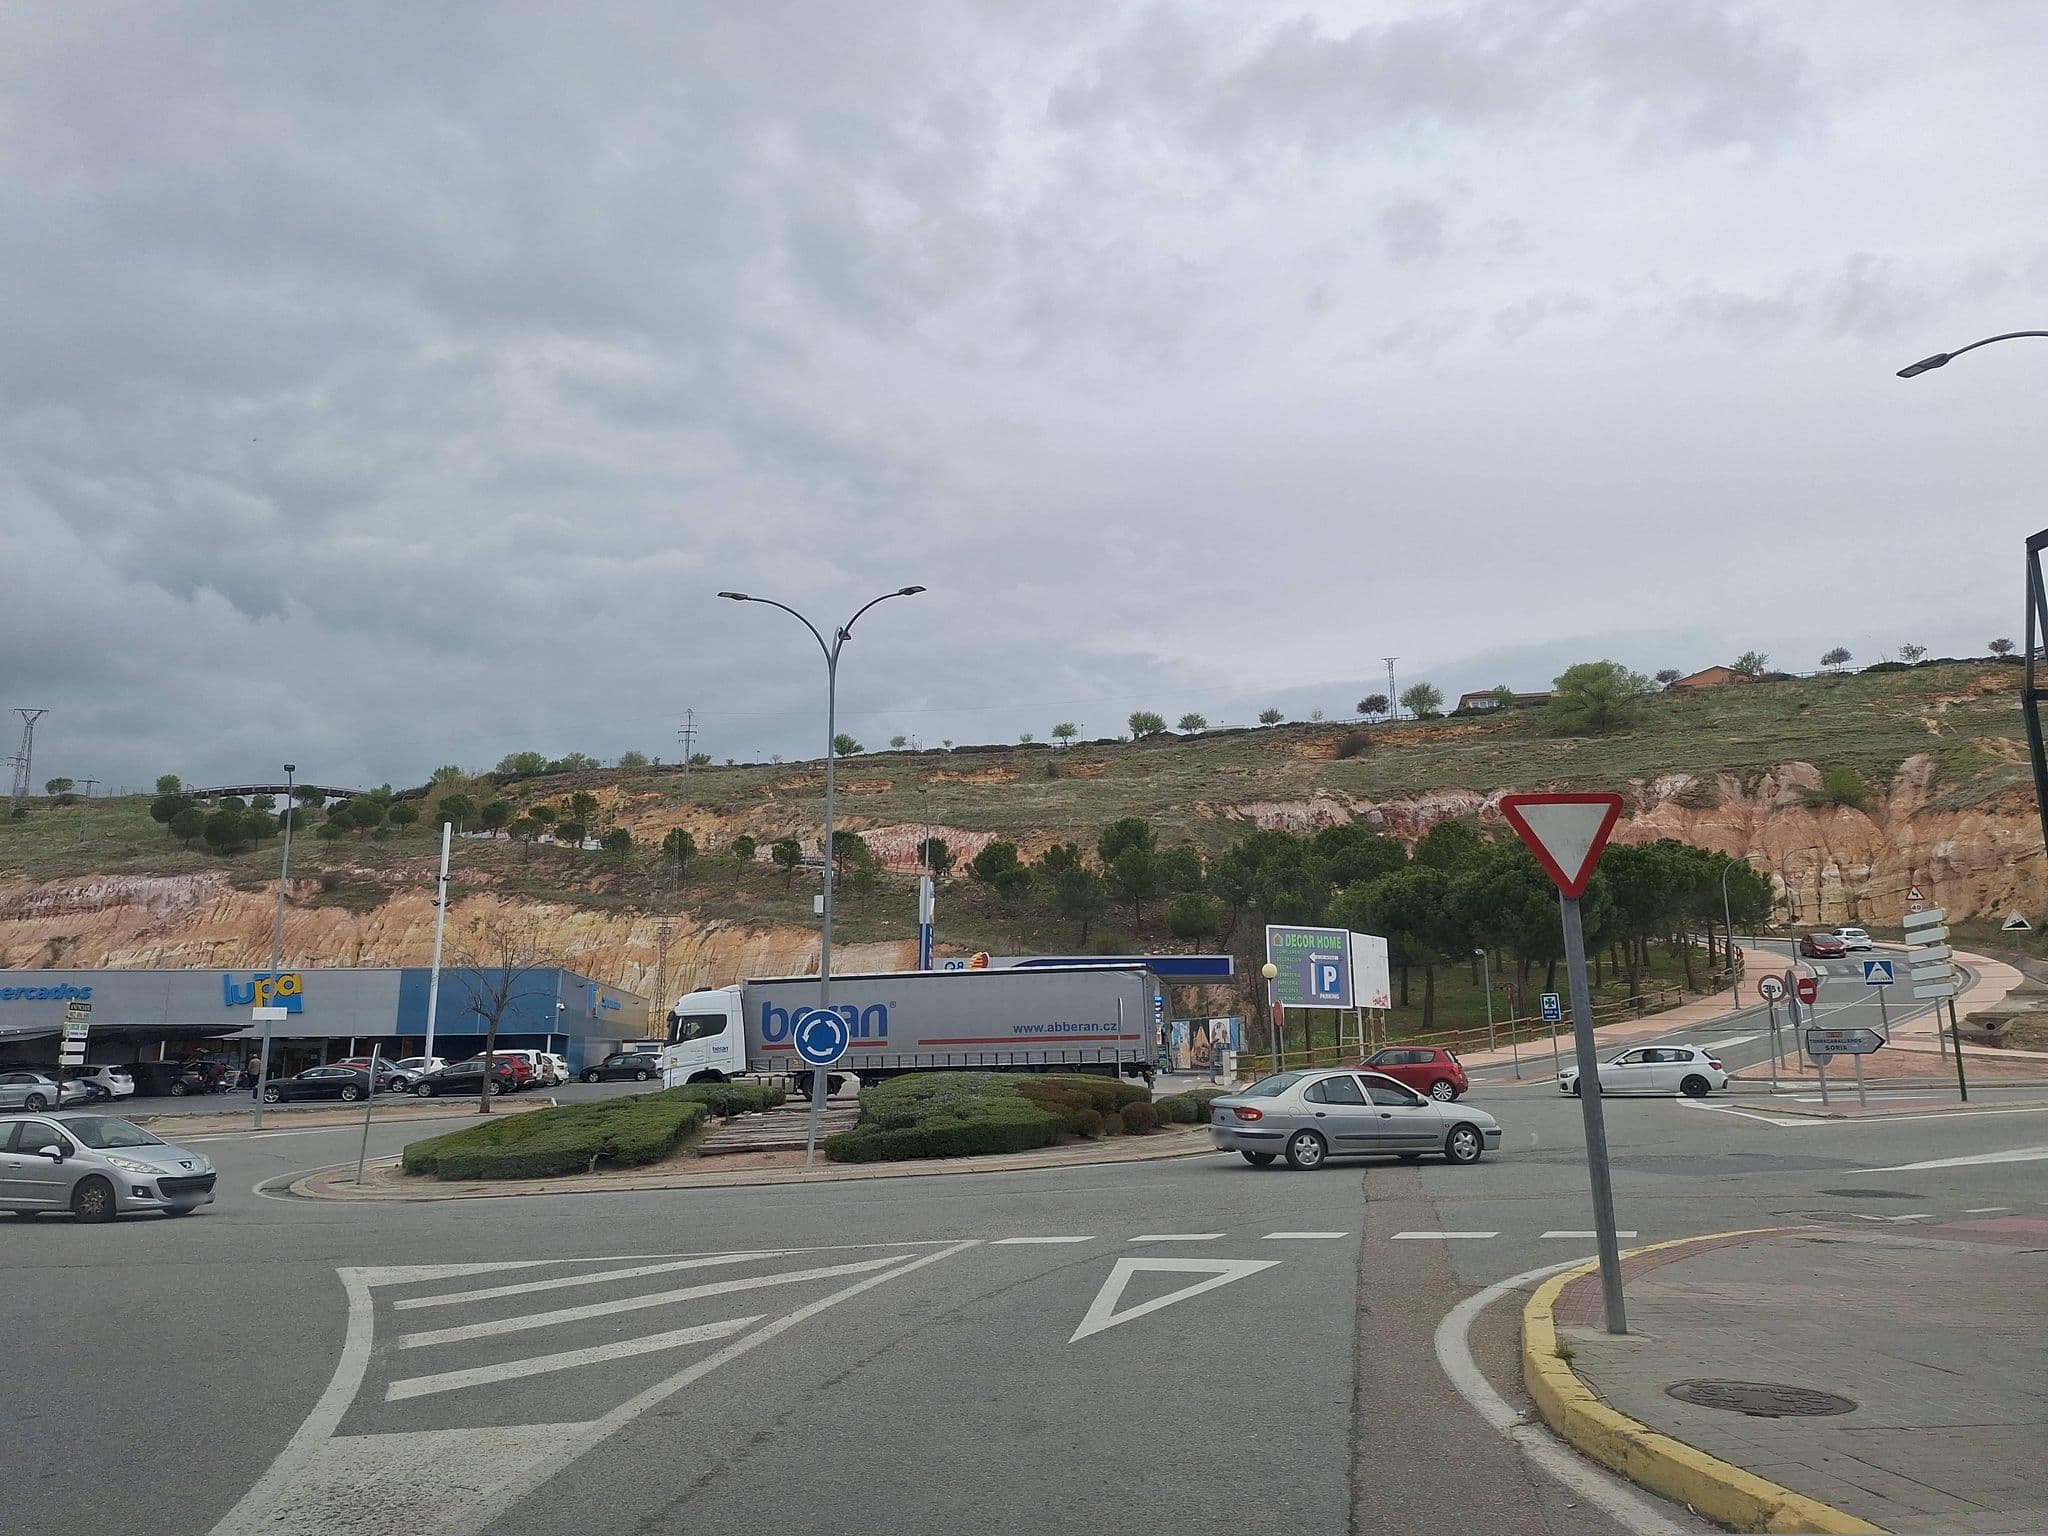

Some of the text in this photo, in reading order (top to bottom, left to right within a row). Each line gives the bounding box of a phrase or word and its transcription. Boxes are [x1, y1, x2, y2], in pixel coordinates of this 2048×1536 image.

[1285, 933, 1342, 949] DECOR HOME
[944, 961, 964, 970] Q8
[1323, 965, 1337, 991] P
[223, 973, 302, 1008] lupa
[1013, 1022, 1117, 1033] www.abberan.cz
